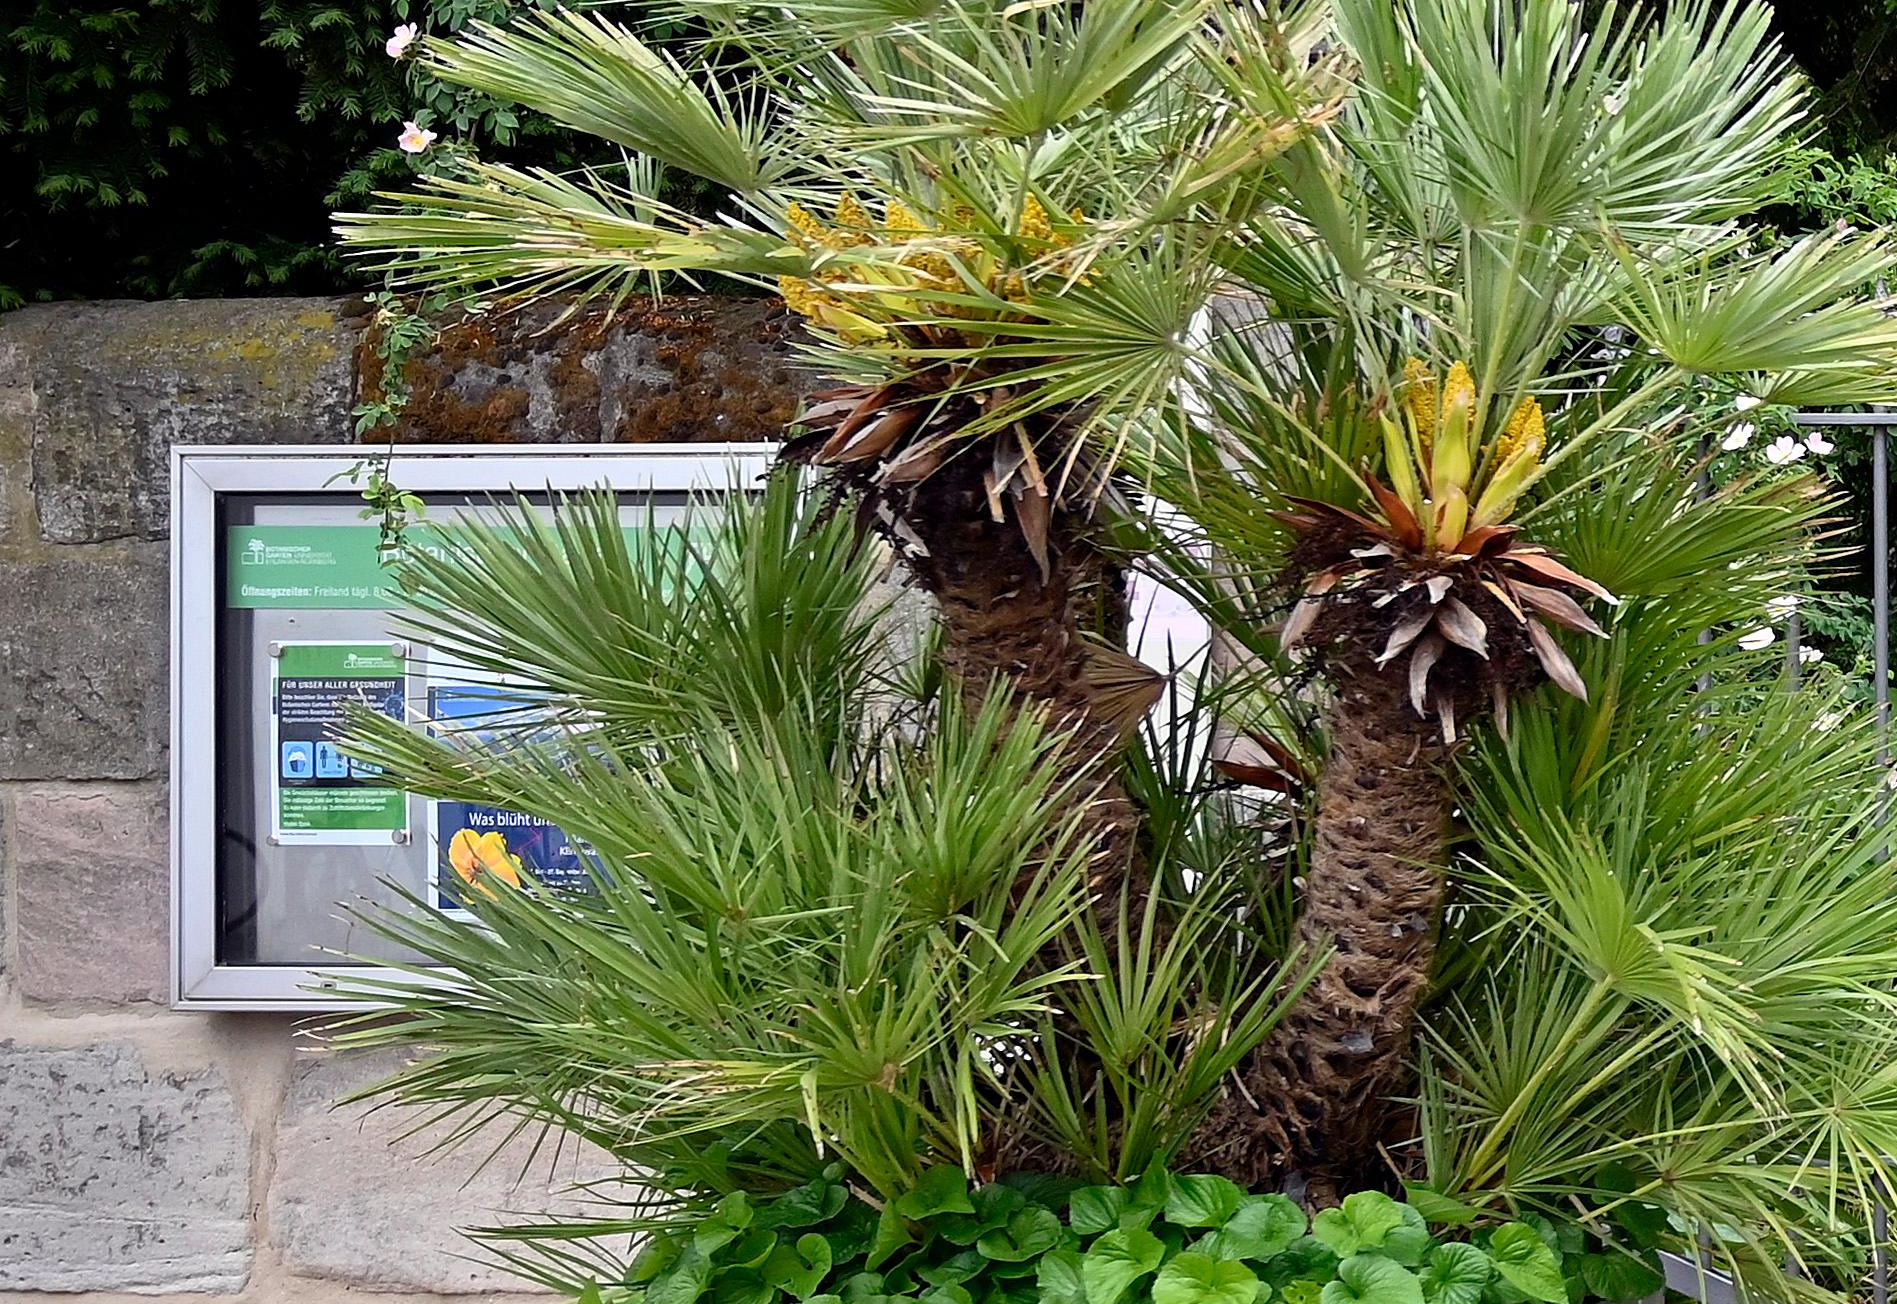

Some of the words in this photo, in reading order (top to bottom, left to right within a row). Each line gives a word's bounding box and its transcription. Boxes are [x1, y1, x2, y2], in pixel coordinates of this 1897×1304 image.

[242, 585, 312, 598] Öffnungszeiten:
[314, 586, 349, 596] Freiland
[351, 586, 371, 598] tägl.
[282, 680, 297, 689] FÜR
[298, 680, 323, 689] UNSER
[324, 680, 348, 689] ALLER
[349, 680, 396, 689] GESUNDHEIT
[469, 813, 495, 826] Was
[497, 812, 531, 826] blüht
